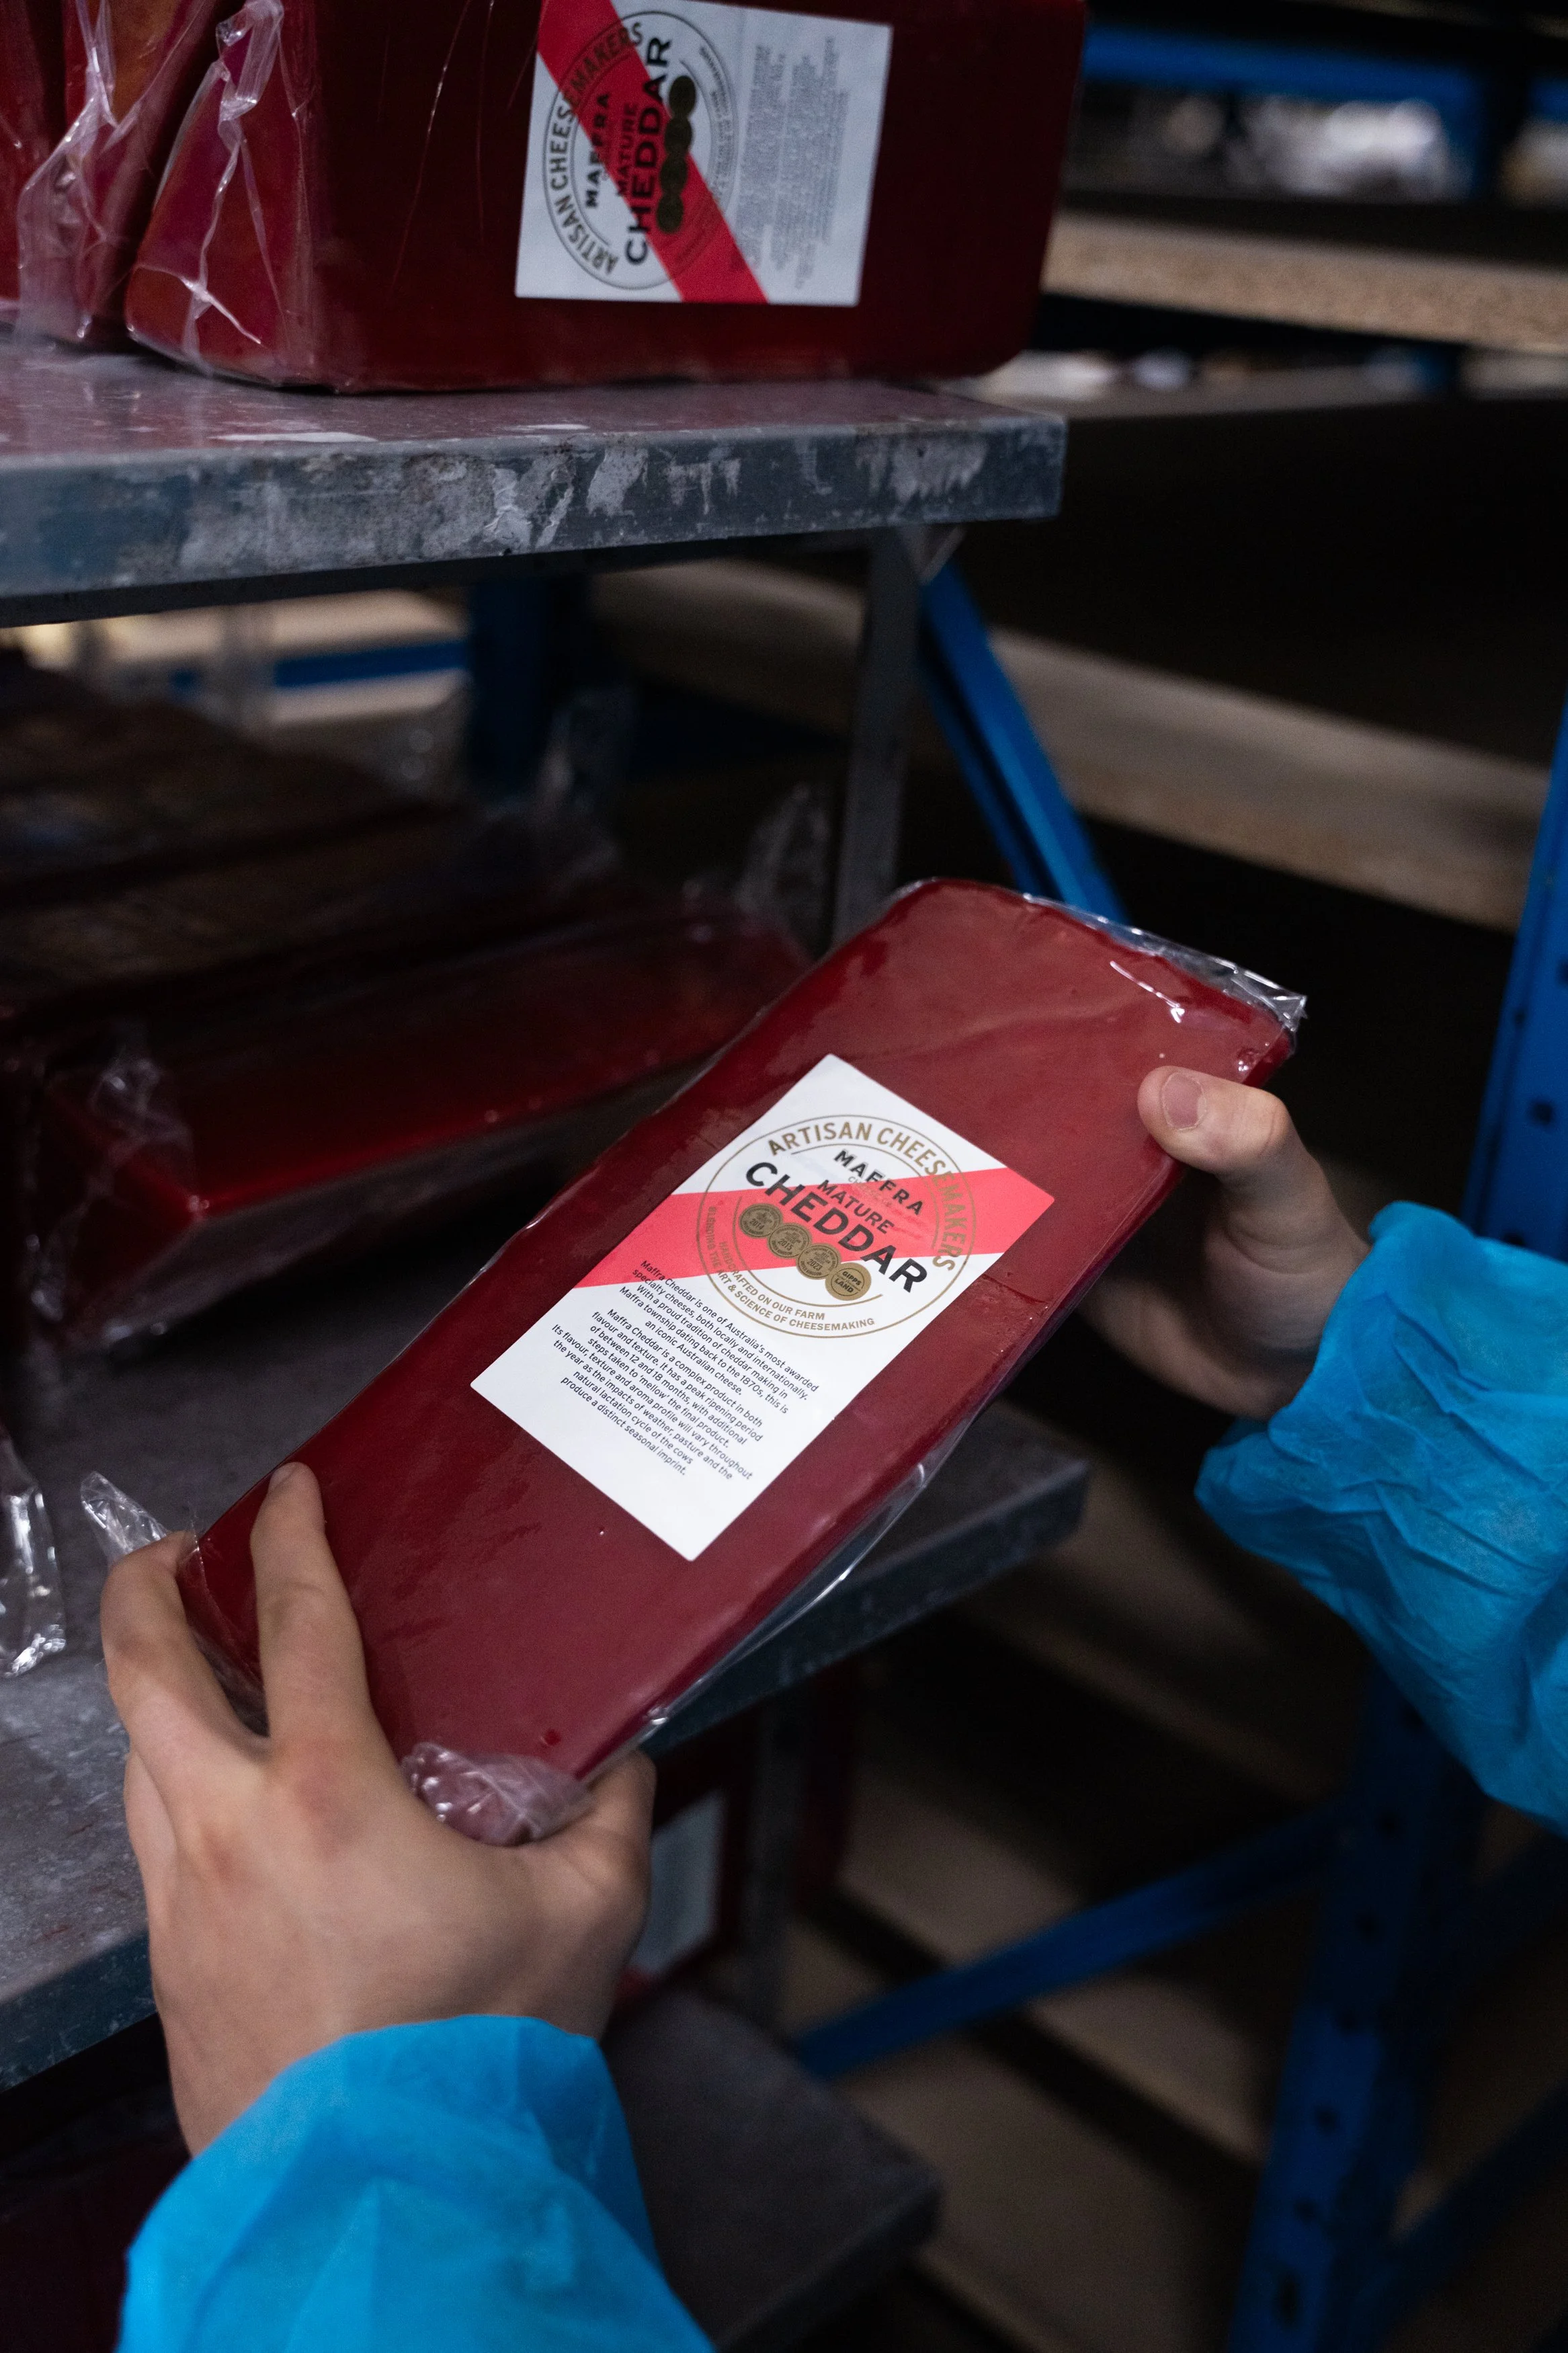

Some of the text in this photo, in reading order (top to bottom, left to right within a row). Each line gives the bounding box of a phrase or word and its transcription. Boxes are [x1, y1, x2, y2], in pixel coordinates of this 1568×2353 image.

[549, 22, 643, 274] ARTISAN CHEESEMAKERS
[585, 93, 610, 208] MAFFRA
[616, 102, 637, 196] MATURE
[624, 36, 671, 266] CHEDDAR
[746, 1162, 927, 1293] CHEDDAR
[749, 1218, 766, 1231] 2014
[768, 1122, 873, 1156] ARTISAN
[876, 1127, 968, 1271] CHEESEMAKERS
[817, 1180, 895, 1234] MATURE
[833, 1150, 923, 1216] MAFFRA
[711, 1251, 721, 1267] THE
[716, 1269, 733, 1284] ART
[728, 1284, 737, 1293] &
[734, 1290, 774, 1318] SCIENCE
[774, 1314, 789, 1324] OF
[789, 1317, 875, 1330] CHEESEMAKING
[719, 1241, 826, 1321] HANDCRAFTED ON OUR FARM
[777, 1238, 794, 1251] 2015
[807, 1259, 823, 1272] 2023
[835, 1278, 854, 1293] LAND
[841, 1271, 862, 1287] GIPPS
[591, 1311, 618, 1332] flavour
[616, 1331, 634, 1345] and
[630, 1341, 659, 1365] texture.
[659, 1362, 668, 1371] It
[665, 1367, 681, 1381] has
[684, 1383, 706, 1400] peak
[704, 1397, 737, 1423] ripening
[734, 1420, 763, 1441] period
[607, 1308, 632, 1330] Maffra
[631, 1327, 663, 1351] Cheddar
[661, 1349, 669, 1357] is
[674, 1360, 706, 1385] complex
[703, 1383, 737, 1407] product
[735, 1404, 744, 1413] in
[743, 1410, 762, 1427] both
[619, 1285, 788, 1413] Maffra township dating back to the 1870s, this is
[632, 1269, 808, 1400] specialty cheeses, both locally and internationally.
[636, 1284, 653, 1300] With
[657, 1302, 683, 1320] proud
[680, 1316, 712, 1343] tradition
[712, 1341, 723, 1349] of
[720, 1348, 752, 1371] cheddar
[750, 1369, 780, 1394] making
[778, 1389, 788, 1398] in
[640, 1260, 665, 1281] Maffra
[665, 1277, 696, 1302] Cheddar
[694, 1299, 703, 1308] is
[702, 1306, 717, 1318] one
[716, 1316, 728, 1324] of
[764, 1351, 785, 1368] most
[784, 1366, 819, 1392] awarded
[645, 1320, 741, 1395] an iconic Australian cheese.
[551, 1324, 752, 1479] Its flavour, texture and aroma profile will vary throughout
[553, 1339, 732, 1479] the year as the impacts of weather, pasture and the
[560, 1377, 592, 1402] produce
[597, 1404, 626, 1427] distinct
[624, 1425, 659, 1452] seasonal
[657, 1449, 686, 1475] imprint.
[573, 1371, 693, 1464] natural lactation cycle of the cows
[587, 1338, 609, 1355] steps
[608, 1352, 629, 1371] taken
[628, 1368, 638, 1378] to
[667, 1397, 681, 1410] the
[680, 1407, 700, 1423] final
[696, 1421, 729, 1447] product.
[589, 1325, 747, 1444] of between 12 and 18 months, with additional
